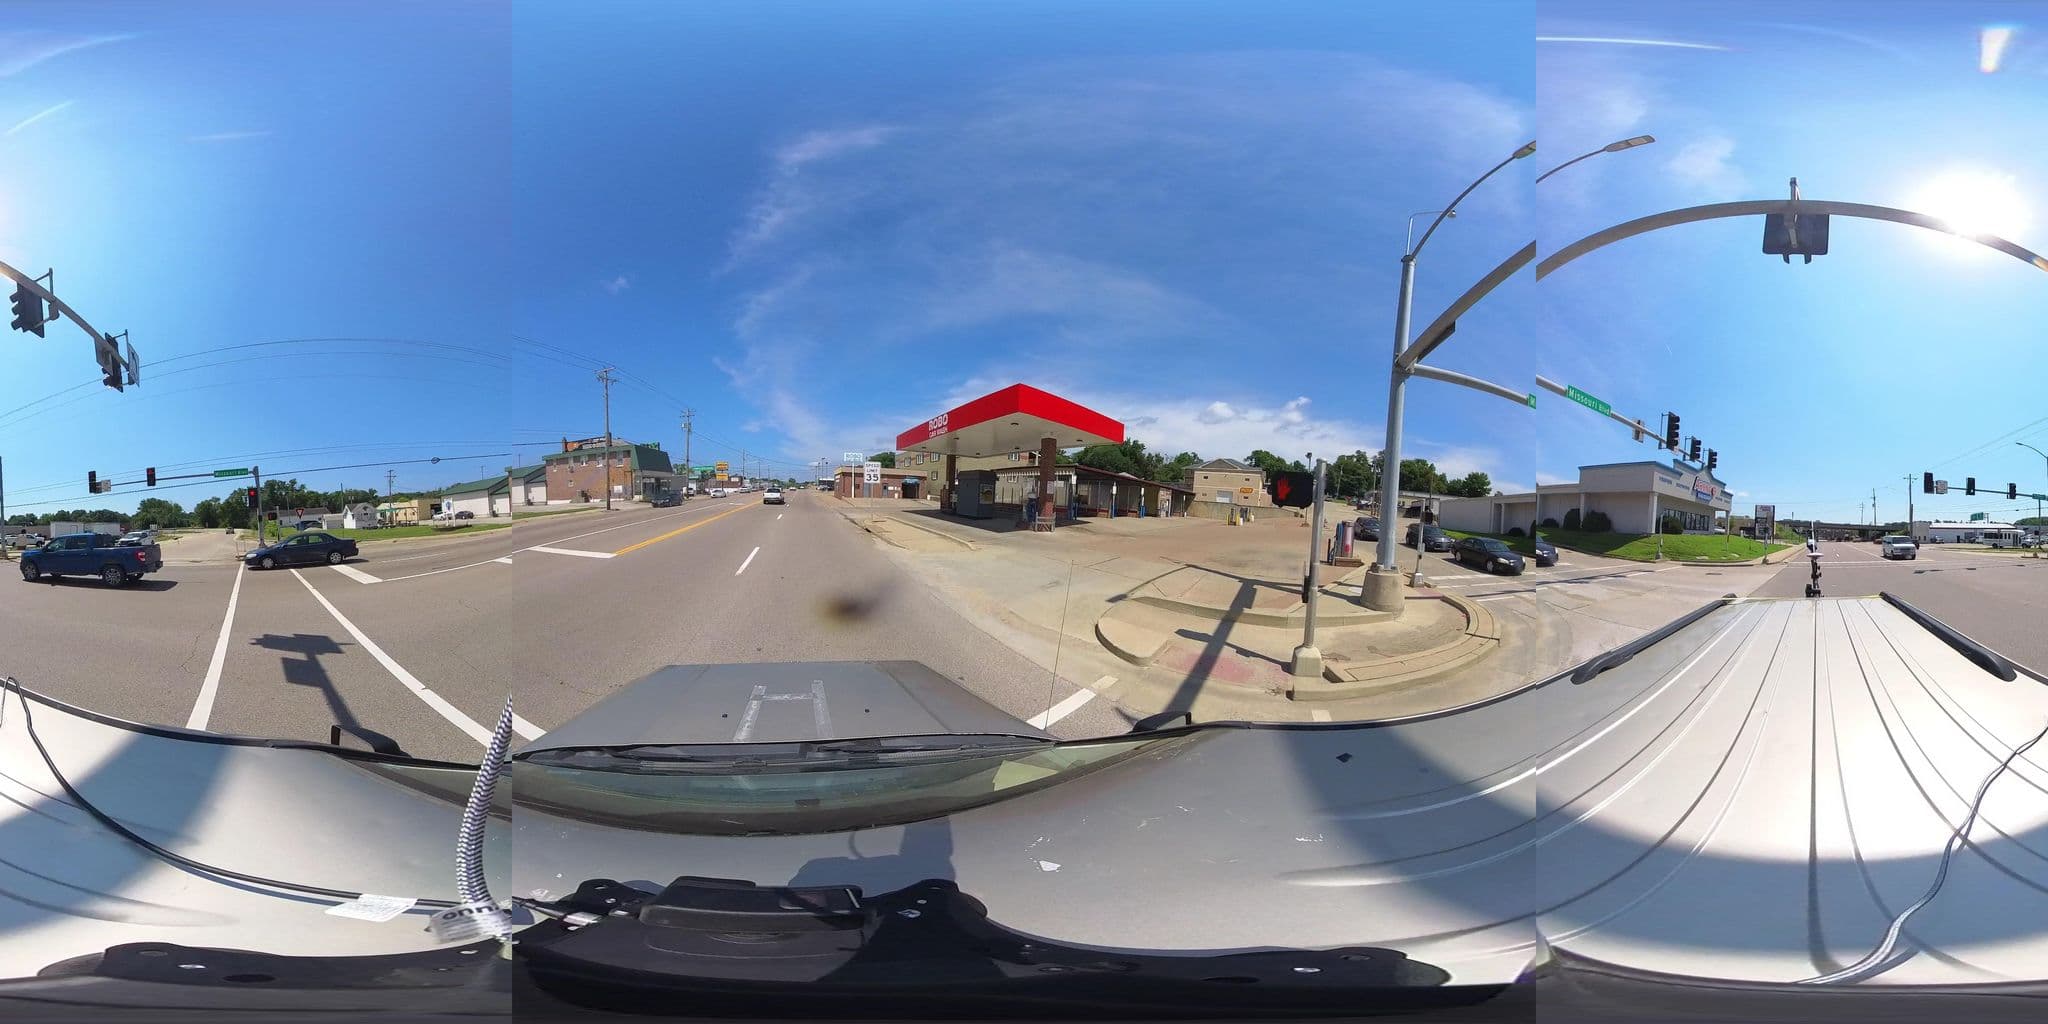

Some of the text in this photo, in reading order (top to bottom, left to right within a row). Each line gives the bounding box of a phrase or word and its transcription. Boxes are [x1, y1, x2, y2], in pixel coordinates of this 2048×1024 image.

[1569, 387, 1610, 415] Missouri Blvd
[928, 414, 949, 430] ROBO
[866, 473, 879, 481] 35
